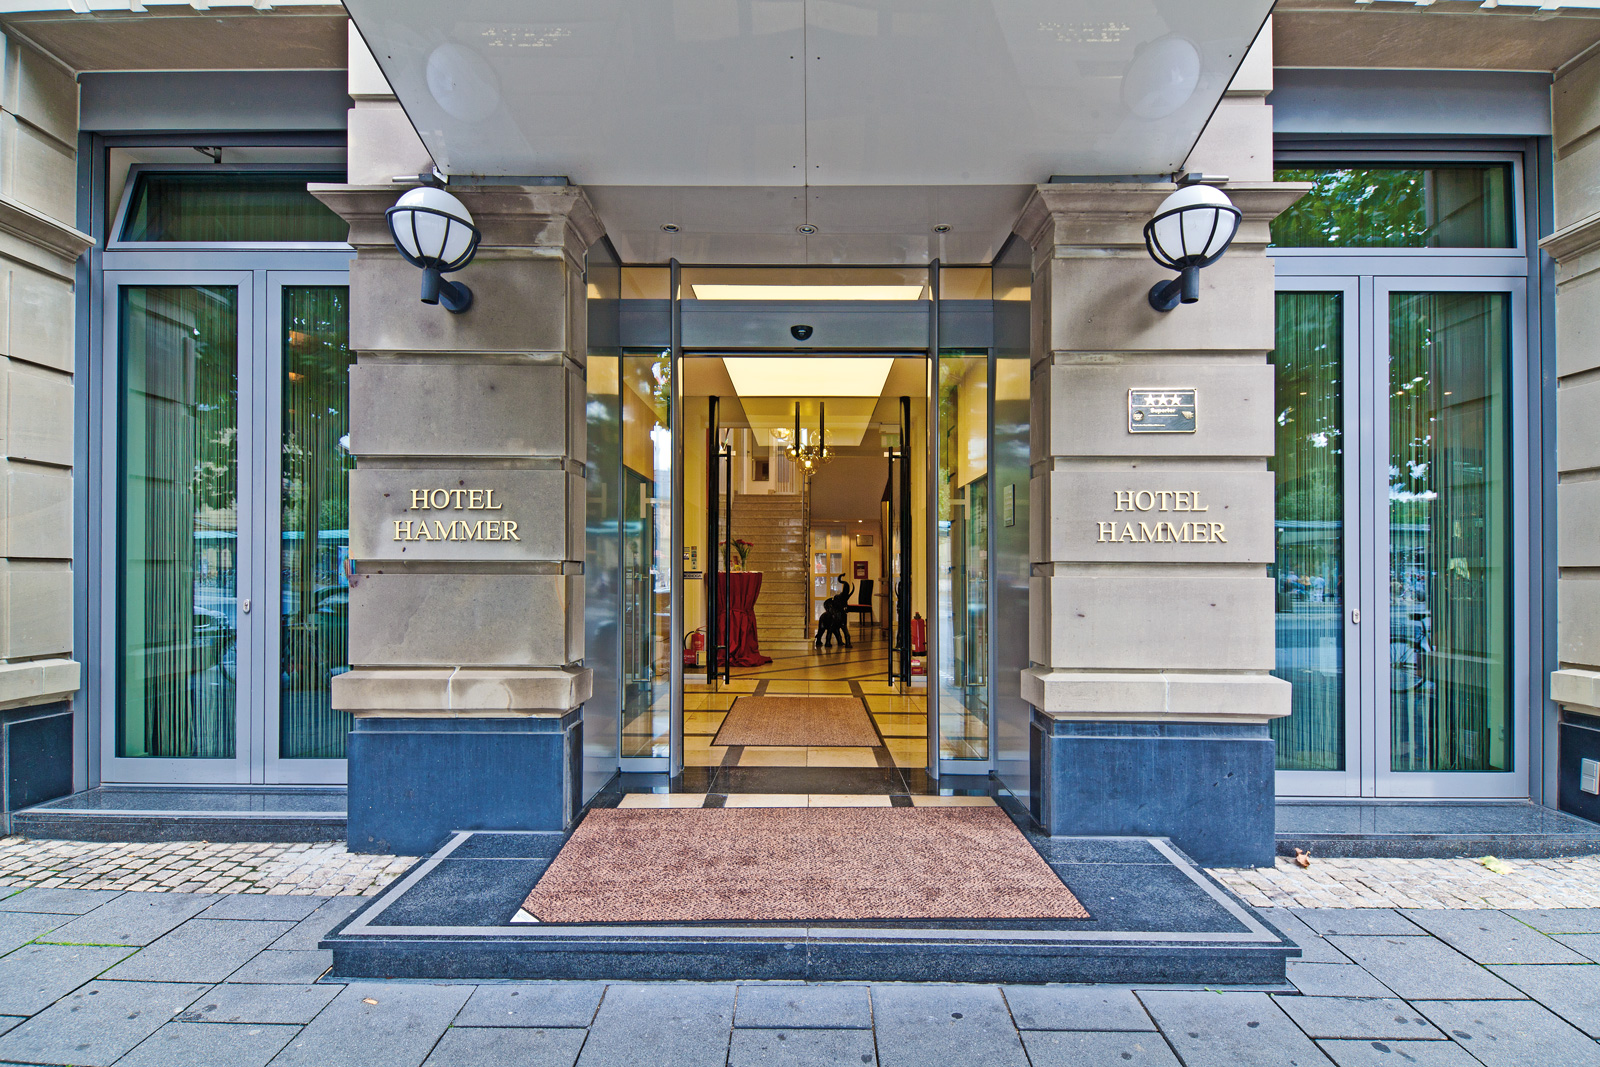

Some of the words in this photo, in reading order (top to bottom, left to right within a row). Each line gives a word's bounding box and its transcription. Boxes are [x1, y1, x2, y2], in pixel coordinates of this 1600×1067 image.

[410, 488, 503, 510] HOTEL
[1114, 490, 1209, 511] HOTEL
[393, 520, 521, 541] HAMMER
[1097, 521, 1228, 543] HAMMER
